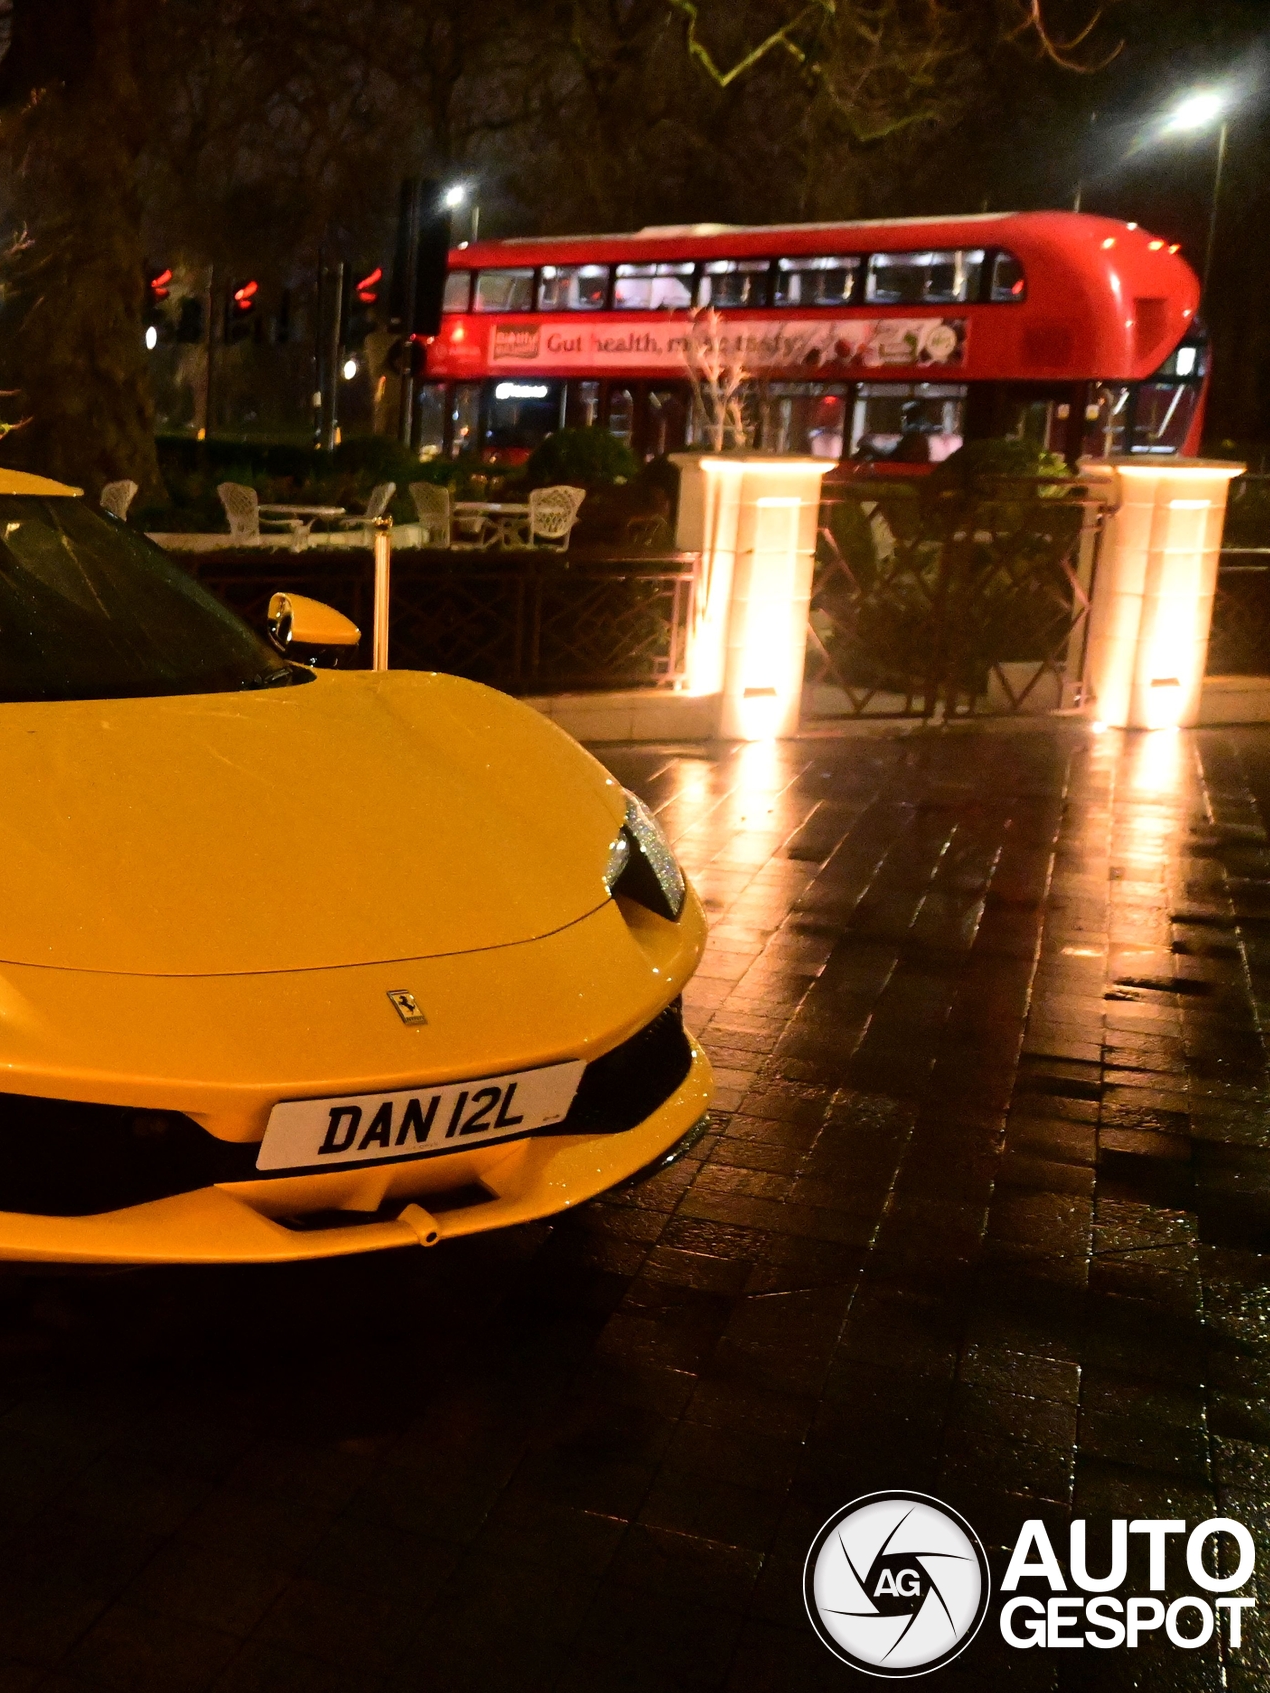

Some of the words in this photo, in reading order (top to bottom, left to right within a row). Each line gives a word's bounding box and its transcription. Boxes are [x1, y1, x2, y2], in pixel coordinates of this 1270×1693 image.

[547, 332, 582, 353] Gut
[667, 335, 729, 354] me
[317, 1096, 441, 1155] DAN
[445, 1083, 523, 1138] 12L
